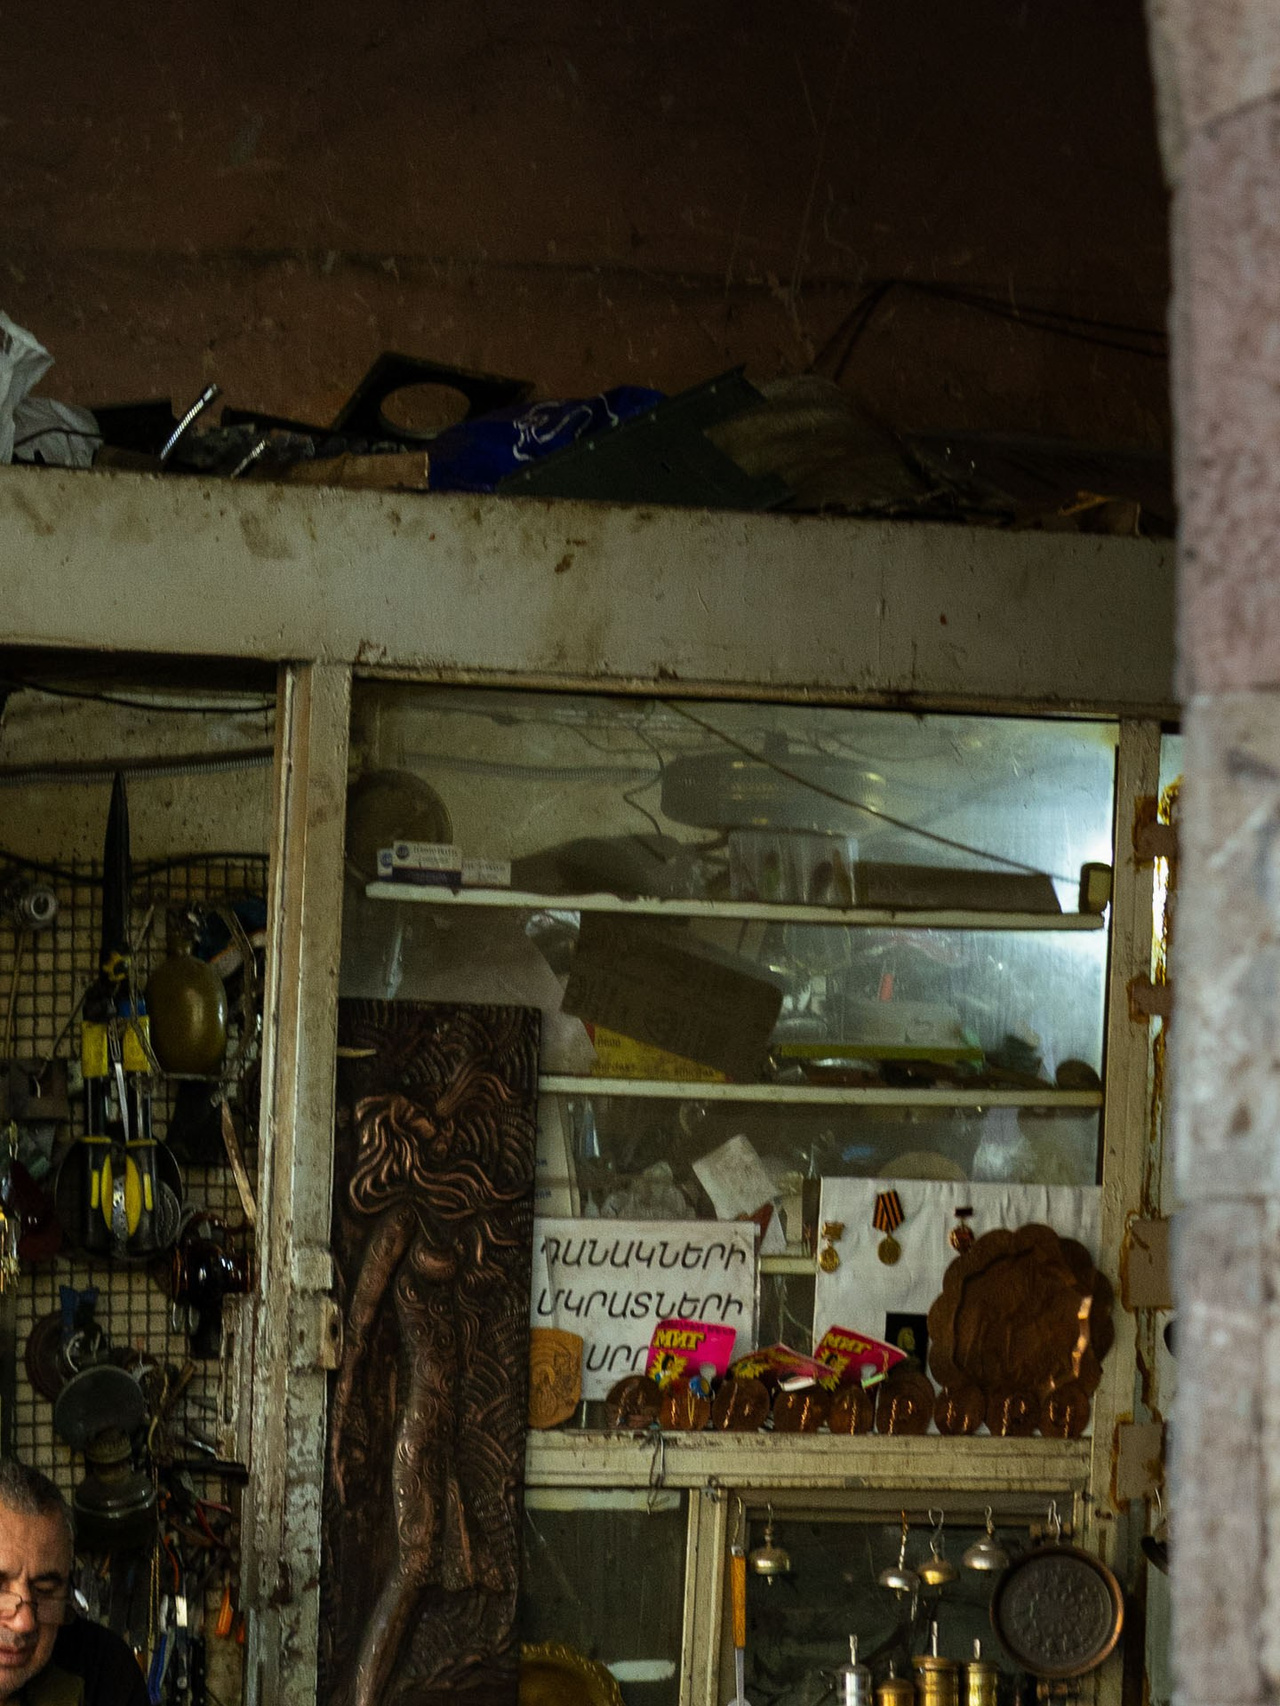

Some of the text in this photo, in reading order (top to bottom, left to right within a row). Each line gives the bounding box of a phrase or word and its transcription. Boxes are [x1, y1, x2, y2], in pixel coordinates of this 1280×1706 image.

[540, 1237, 747, 1272] ԴԱՆԱԿՆԵՐԻ
[536, 1288, 744, 1321] ՄԿՐԱՏՆԵՐԻ
[653, 1328, 706, 1351] МИГ
